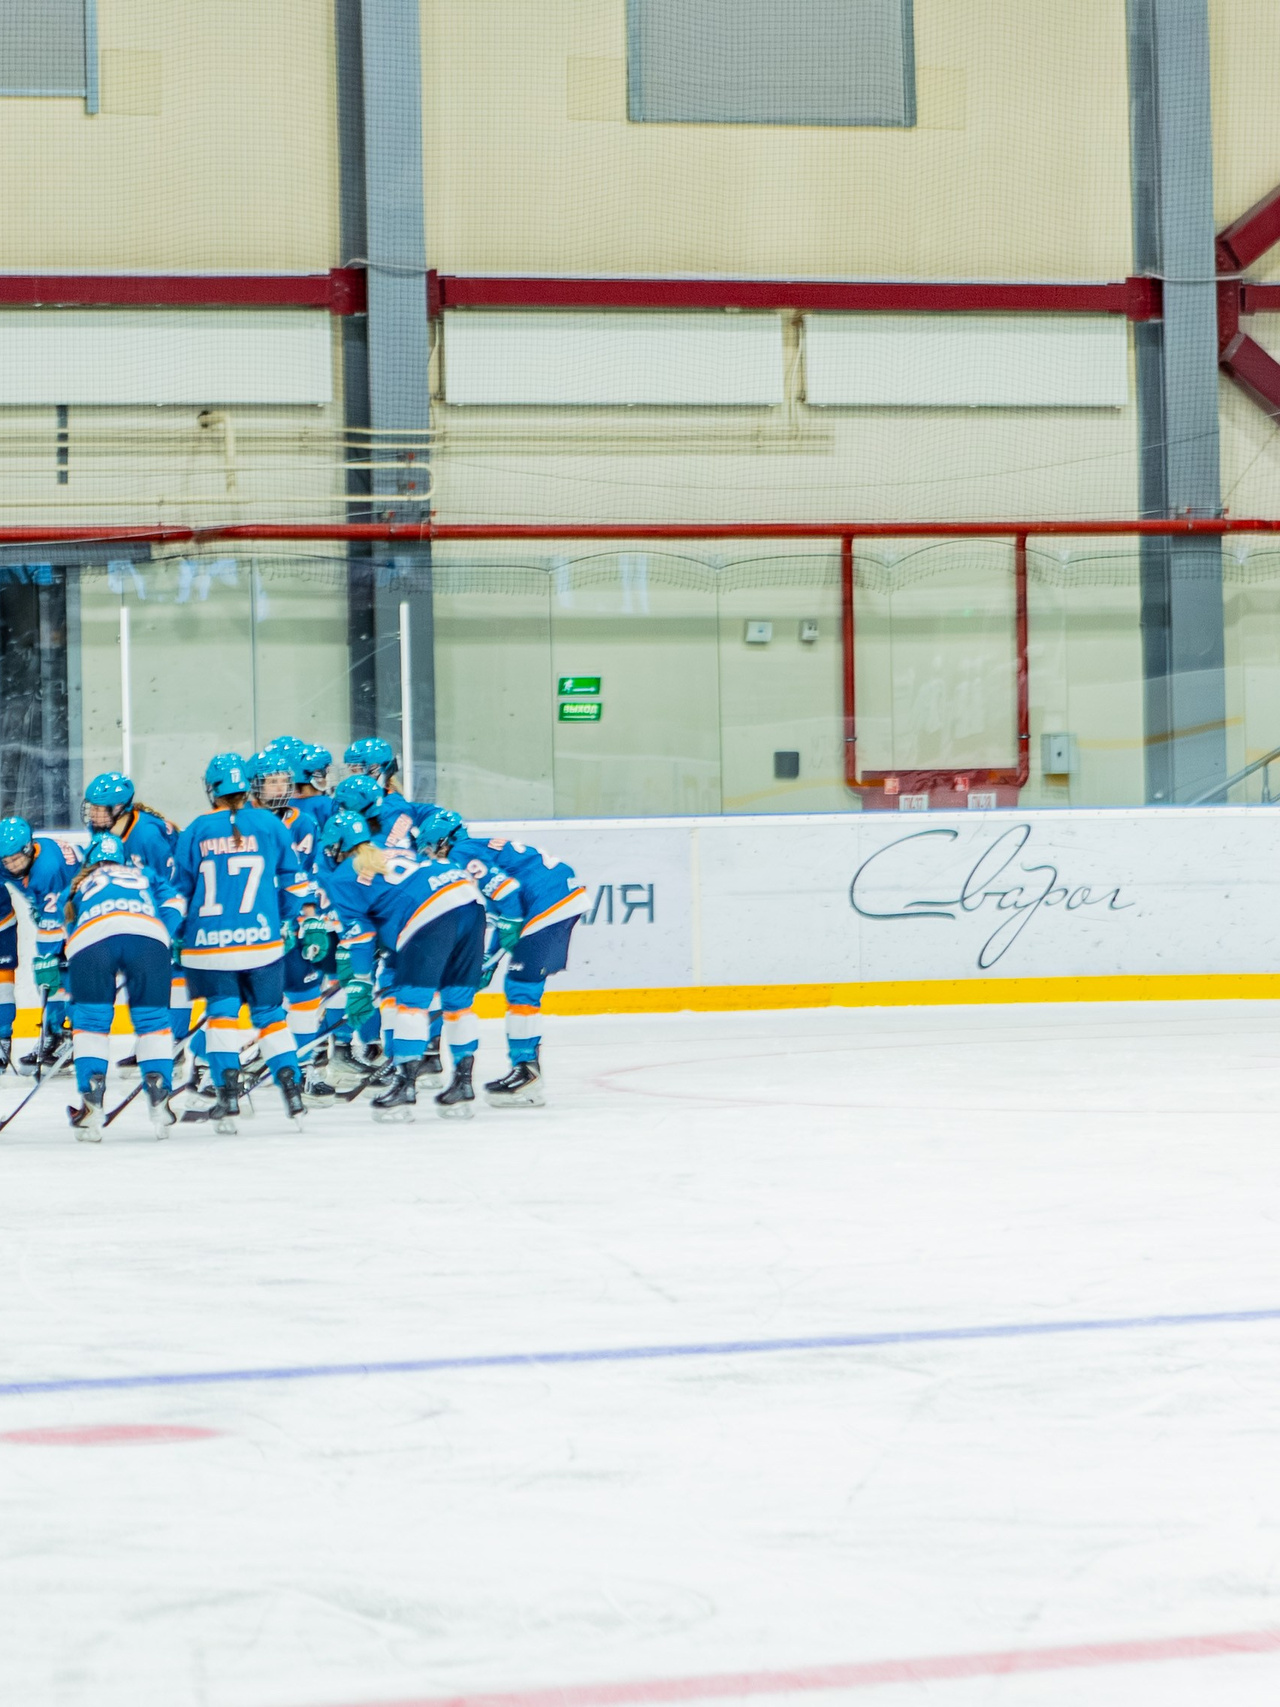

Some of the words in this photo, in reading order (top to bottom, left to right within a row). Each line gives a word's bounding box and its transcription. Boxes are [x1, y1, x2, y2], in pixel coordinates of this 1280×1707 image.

[563, 704, 598, 714] ВЫХОД
[199, 855, 265, 917] 17
[195, 913, 271, 947] Аврора
